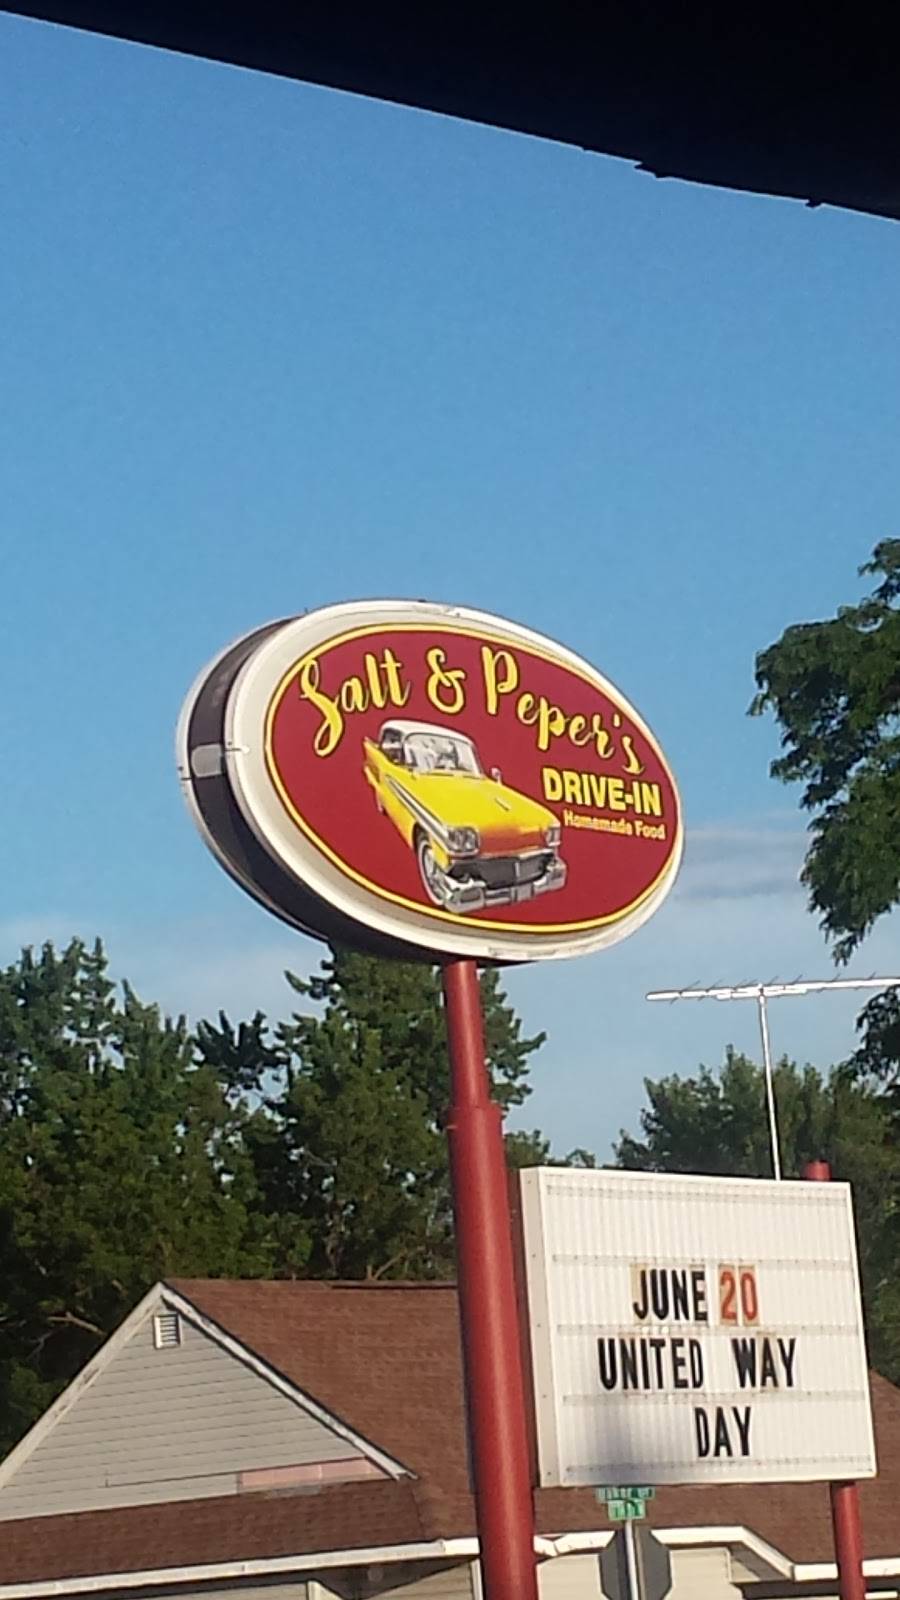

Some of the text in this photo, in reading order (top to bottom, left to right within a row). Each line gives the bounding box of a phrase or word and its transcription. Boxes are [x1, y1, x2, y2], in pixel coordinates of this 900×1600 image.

[300, 645, 646, 775] Salt & Peper's
[542, 767, 663, 817] DRIVE-IN
[563, 809, 667, 840] Homemade Food
[632, 1269, 758, 1321] JUNE 20
[597, 1337, 796, 1391] UNITED WAY
[694, 1406, 751, 1458] DAY
